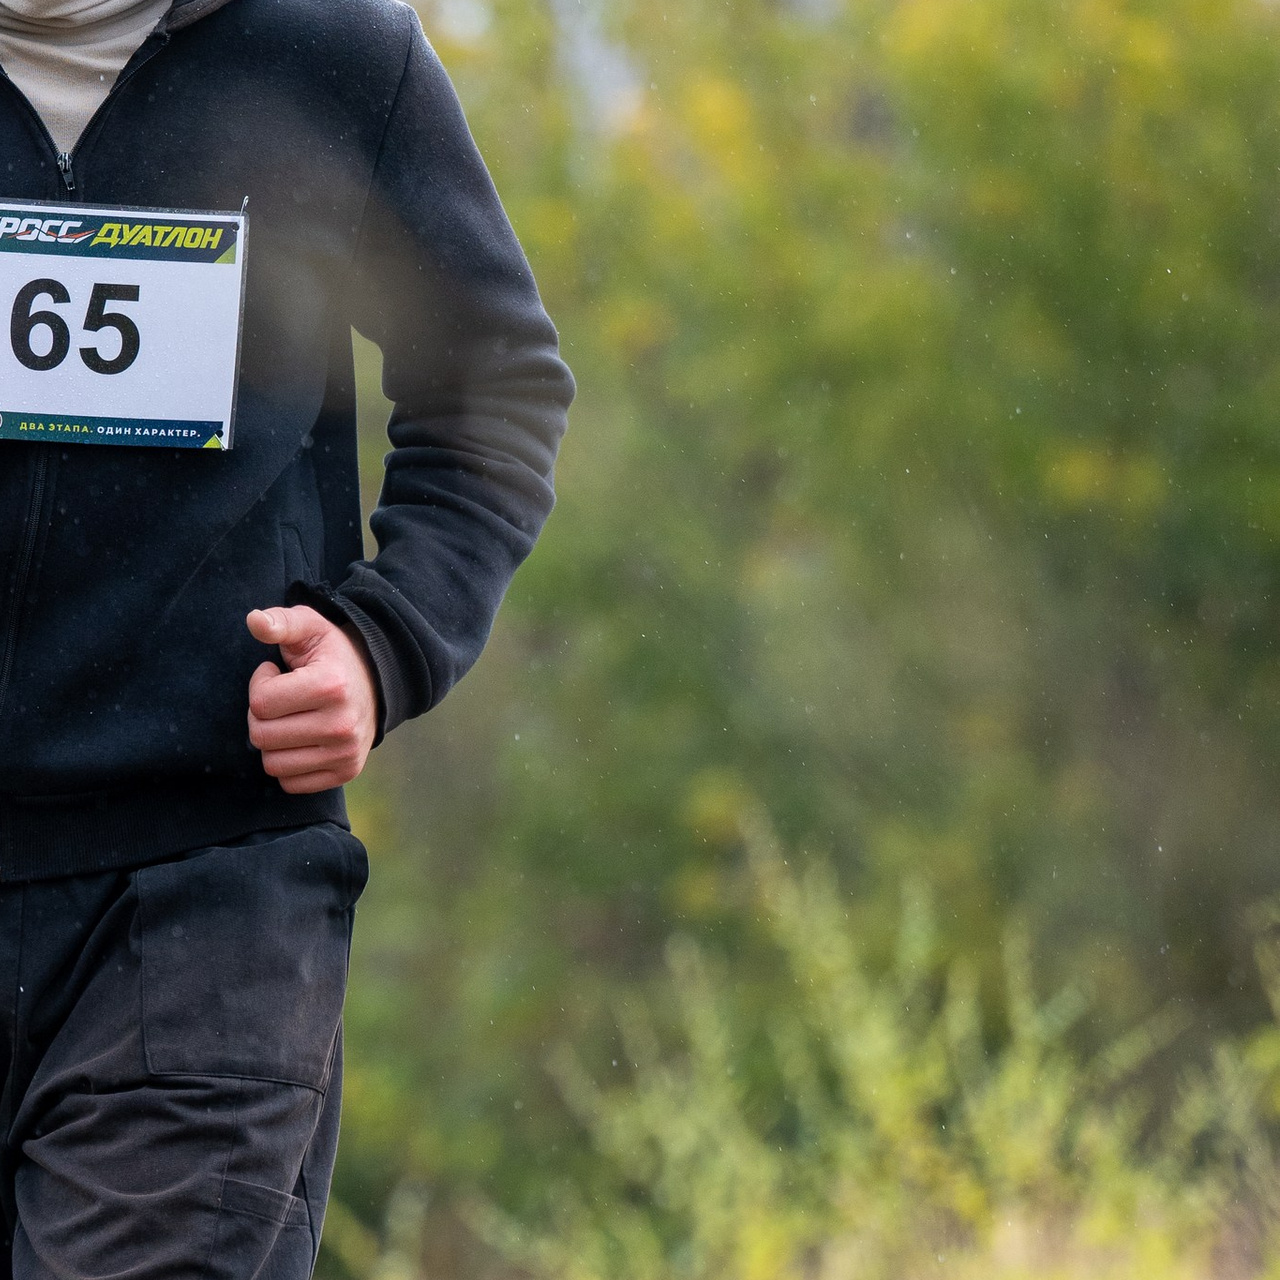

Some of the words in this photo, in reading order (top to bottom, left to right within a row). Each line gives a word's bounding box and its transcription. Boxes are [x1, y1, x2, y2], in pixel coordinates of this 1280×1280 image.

[90, 222, 224, 249] ДУАТЛОН
[10, 278, 141, 376] 65
[19, 421, 45, 432] ДВА
[48, 422, 94, 434] ЭТАПА.
[97, 426, 132, 437] ОДИН
[134, 427, 202, 438] ХАРАКТЕР.
